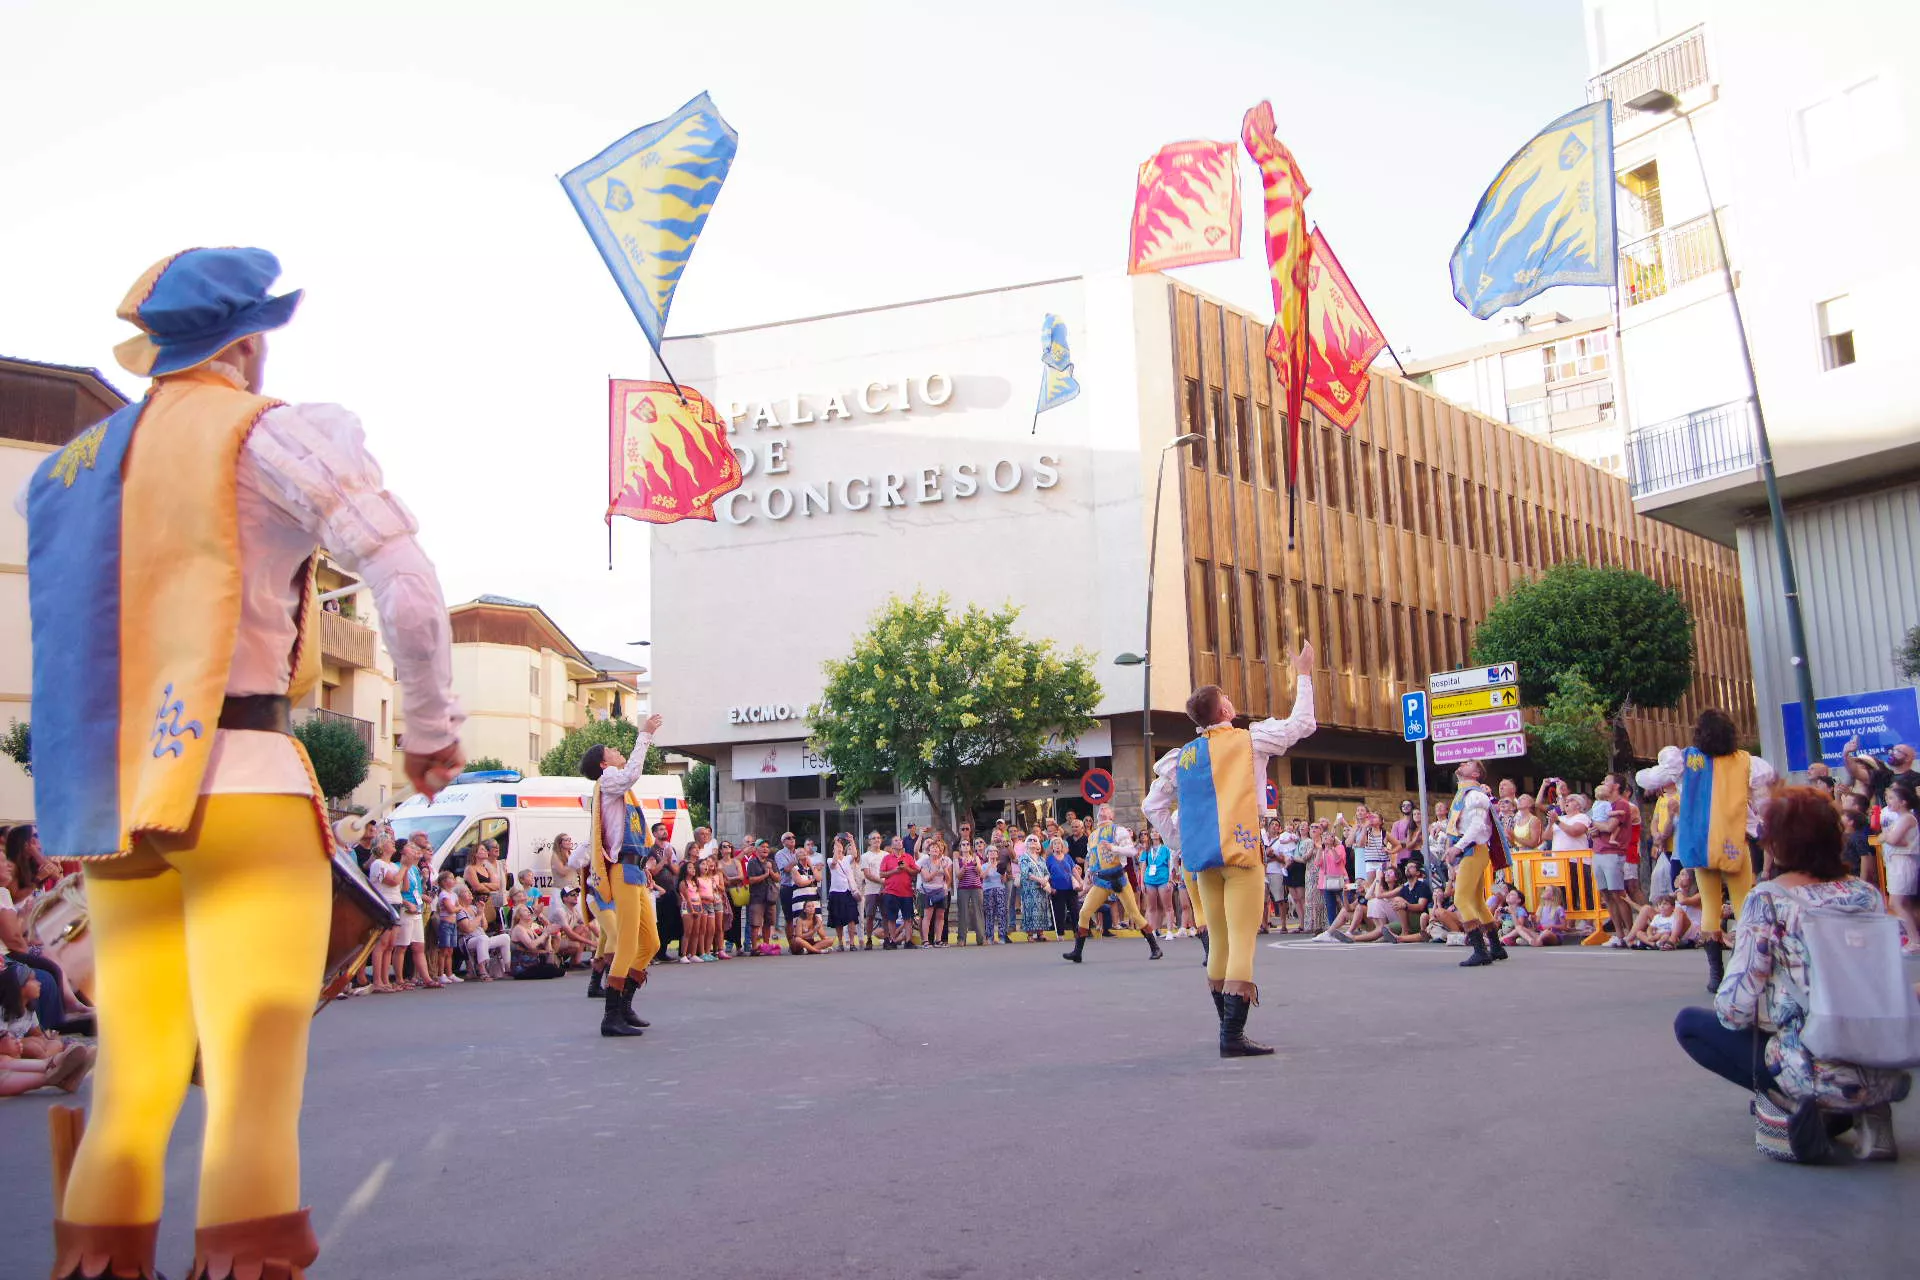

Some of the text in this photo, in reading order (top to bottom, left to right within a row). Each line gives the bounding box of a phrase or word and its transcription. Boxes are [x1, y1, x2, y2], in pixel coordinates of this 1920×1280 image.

[726, 373, 954, 434] PALACIO
[732, 439, 790, 477] DE
[724, 453, 1062, 525] CONGRESOS
[1431, 676, 1460, 690] hospital
[727, 703, 796, 725] EXCMO.
[1407, 698, 1419, 716] P
[1815, 704, 1889, 720] XIMA CONSTRUCCIÓN
[1817, 715, 1885, 730] RAJES Y TRASTEROS
[1434, 728, 1459, 738] La Paz
[1818, 731, 1834, 739] UAN
[1851, 727, 1856, 735] Y
[1867, 723, 1887, 734] ANSÓ
[533, 876, 553, 888] ruz
